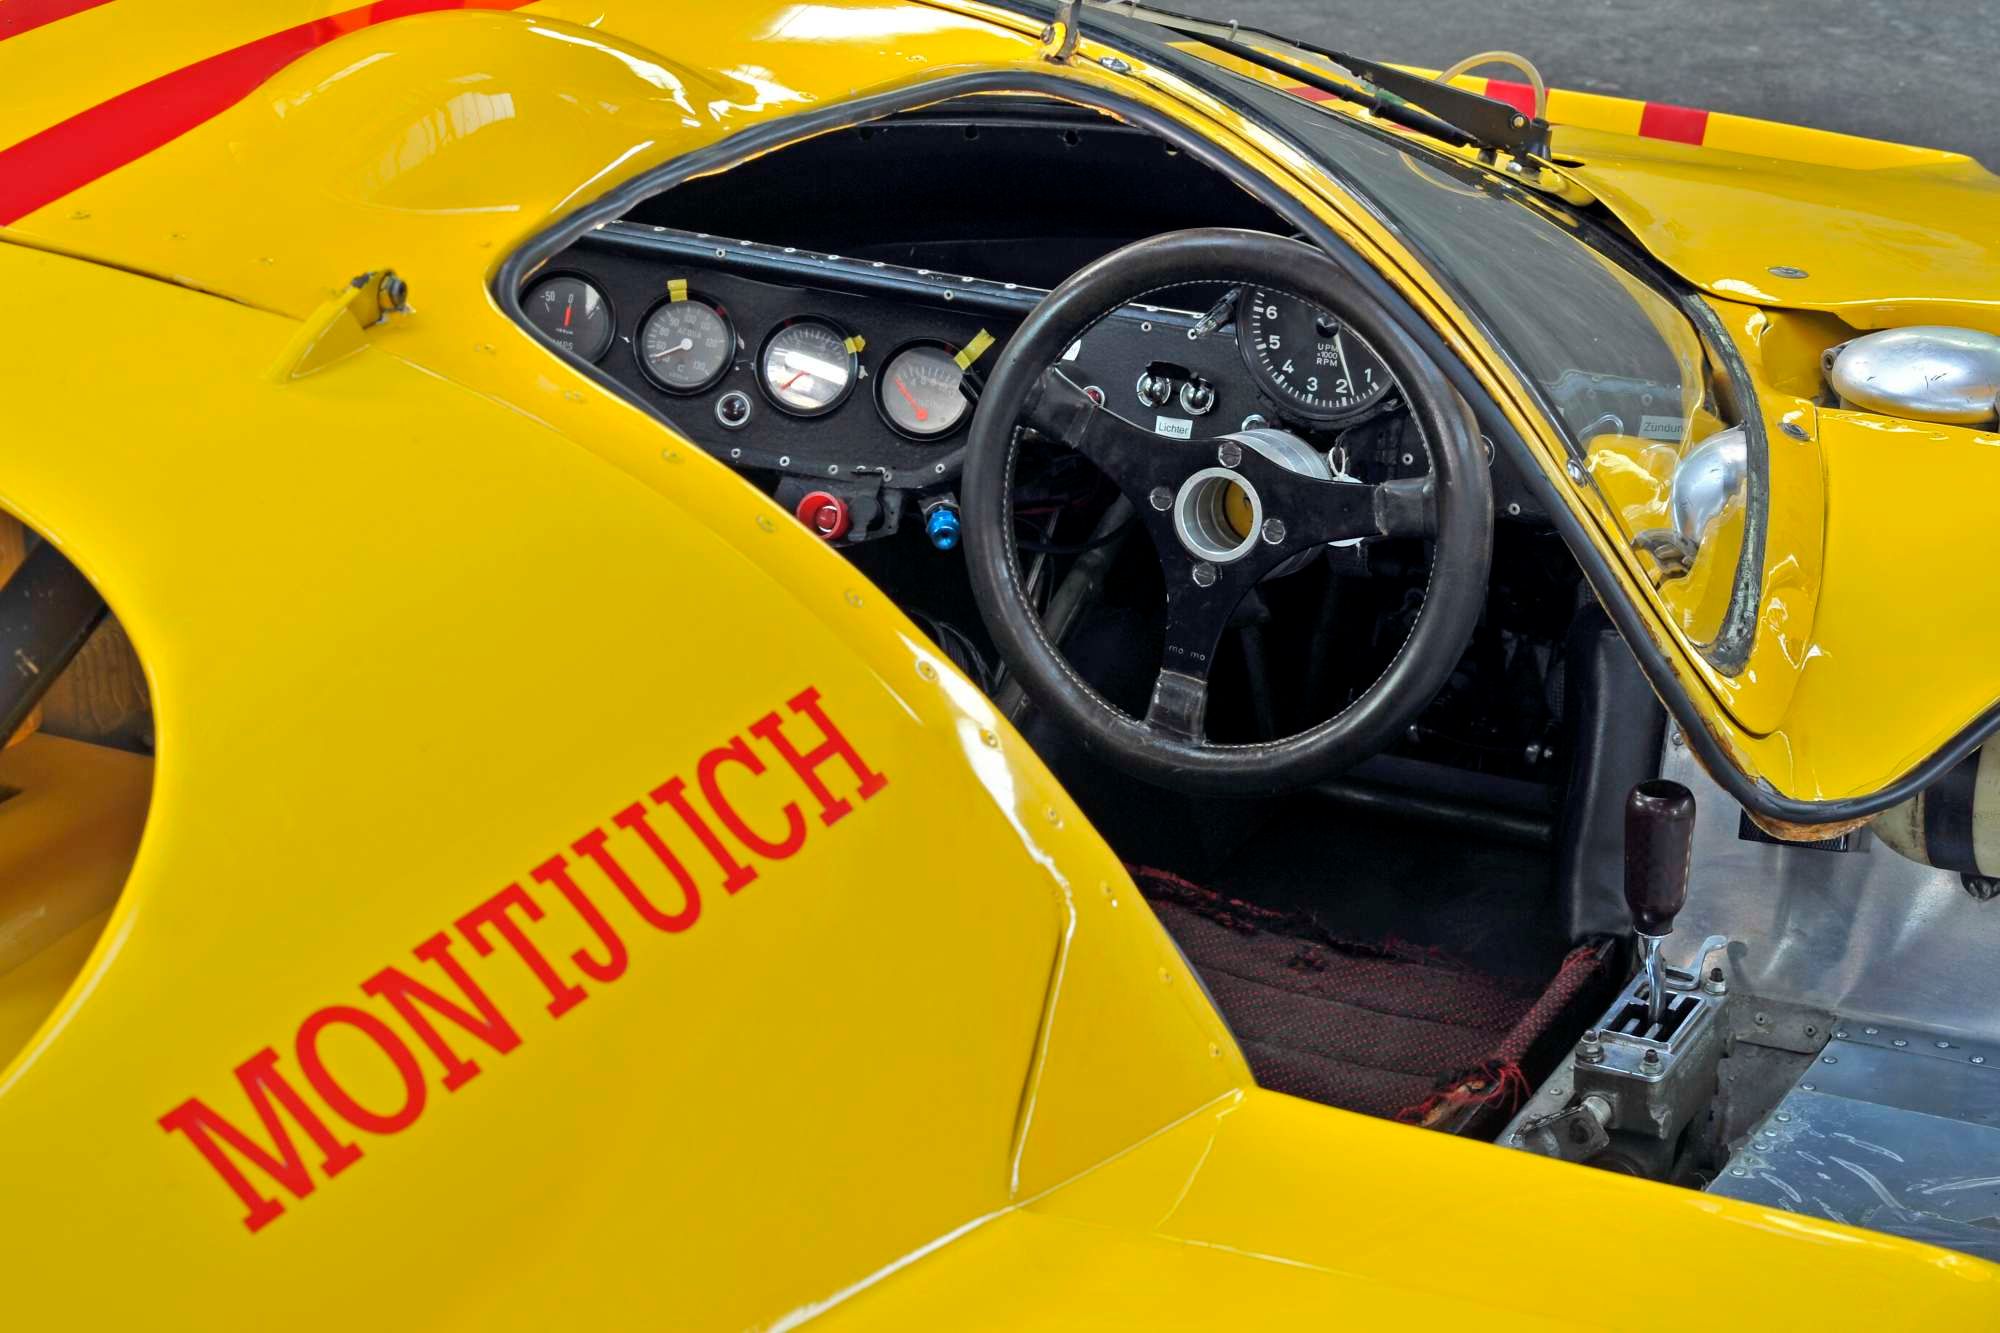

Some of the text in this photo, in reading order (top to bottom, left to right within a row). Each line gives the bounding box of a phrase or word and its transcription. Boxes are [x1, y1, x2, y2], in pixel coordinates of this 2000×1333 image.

[540, 290, 556, 302] -50
[567, 293, 575, 304] 0
[1265, 305, 1278, 320] 6
[1268, 334, 1281, 350] 5
[1281, 359, 1295, 374] 4
[1316, 357, 1339, 368] RPM
[1364, 367, 1372, 383] 1
[1306, 376, 1318, 392] 3
[1335, 378, 1348, 394] 2
[1158, 422, 1190, 435] Lichter
[156, 685, 889, 1235] MONTJUICH
